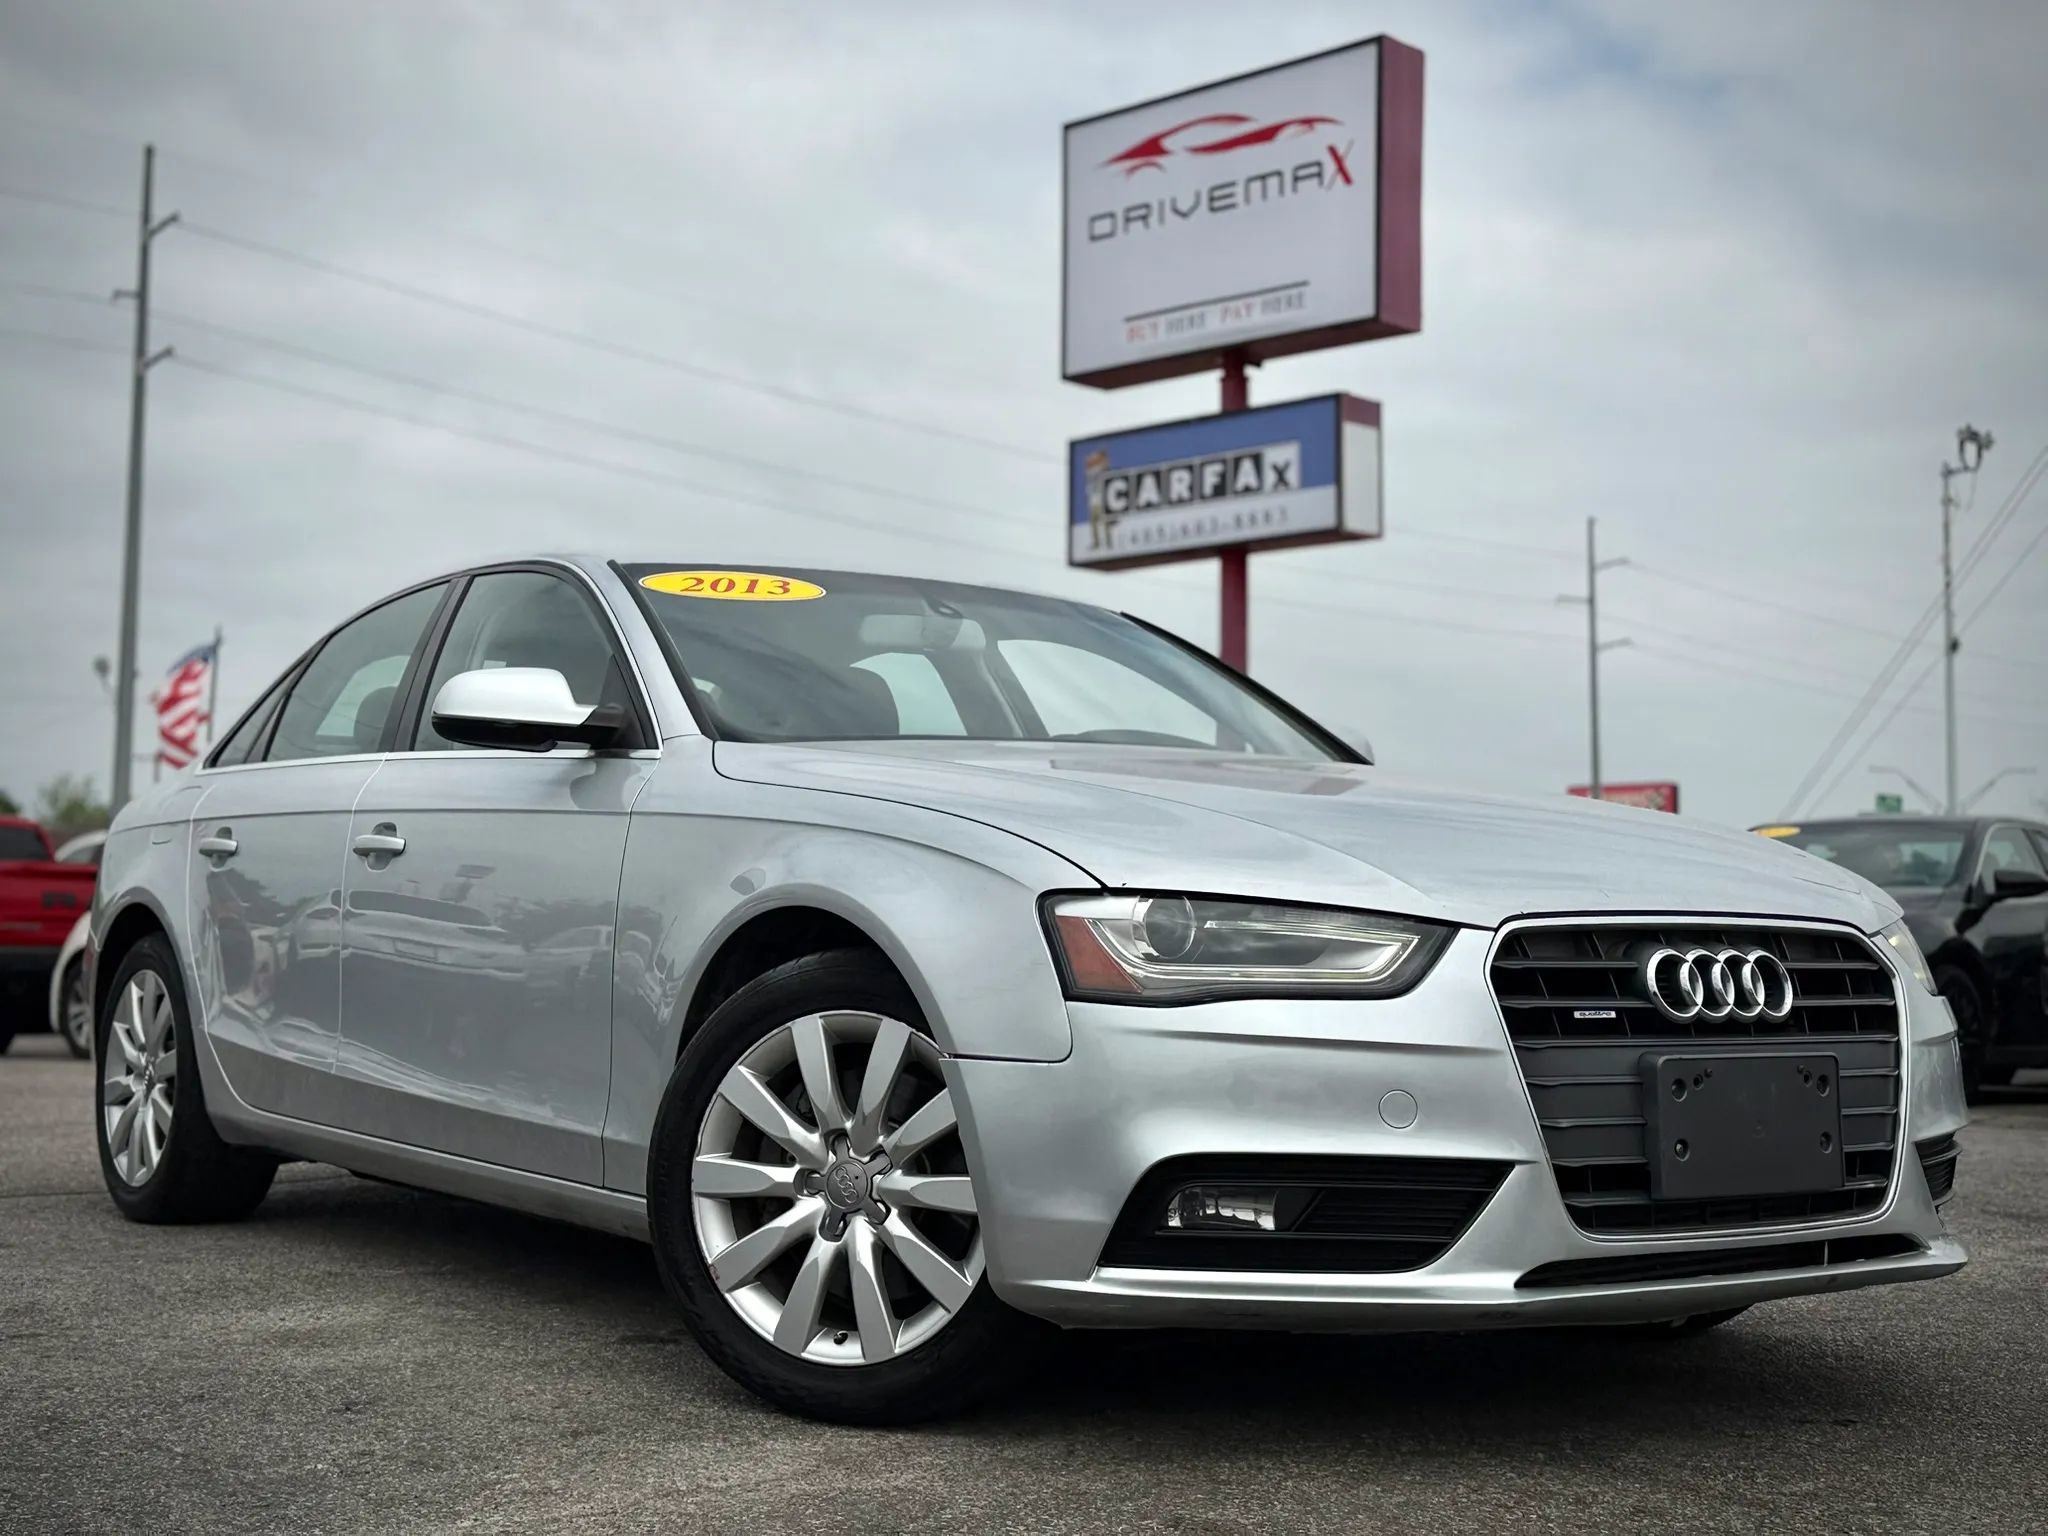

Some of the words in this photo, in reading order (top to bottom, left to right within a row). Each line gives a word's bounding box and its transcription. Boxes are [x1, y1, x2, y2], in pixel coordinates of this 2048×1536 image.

[1088, 140, 1354, 242] DRIVEMAX
[1105, 451, 1294, 514] CARFAX
[680, 577, 791, 596] 2013
